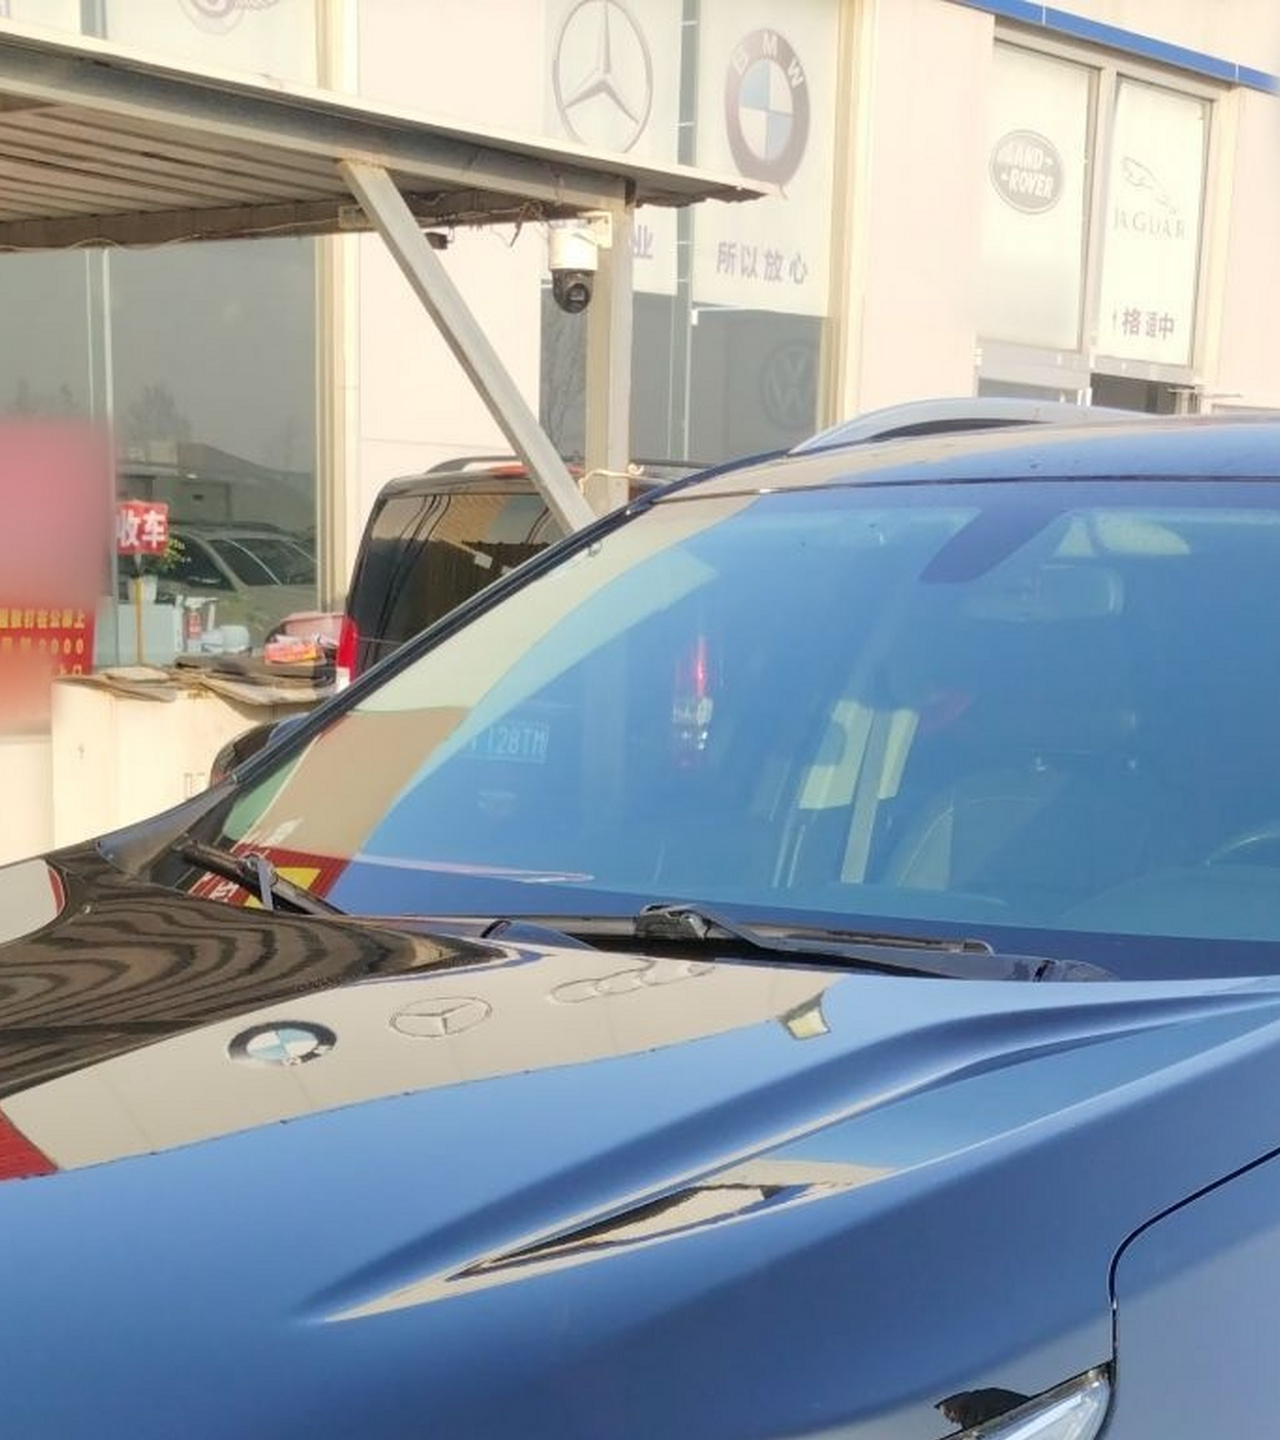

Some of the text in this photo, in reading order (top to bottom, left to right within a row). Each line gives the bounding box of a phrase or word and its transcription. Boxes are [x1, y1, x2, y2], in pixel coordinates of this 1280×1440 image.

[731, 31, 804, 88] BMW
[1009, 169, 1054, 197] ROVER
[717, 242, 808, 284] 所以放心
